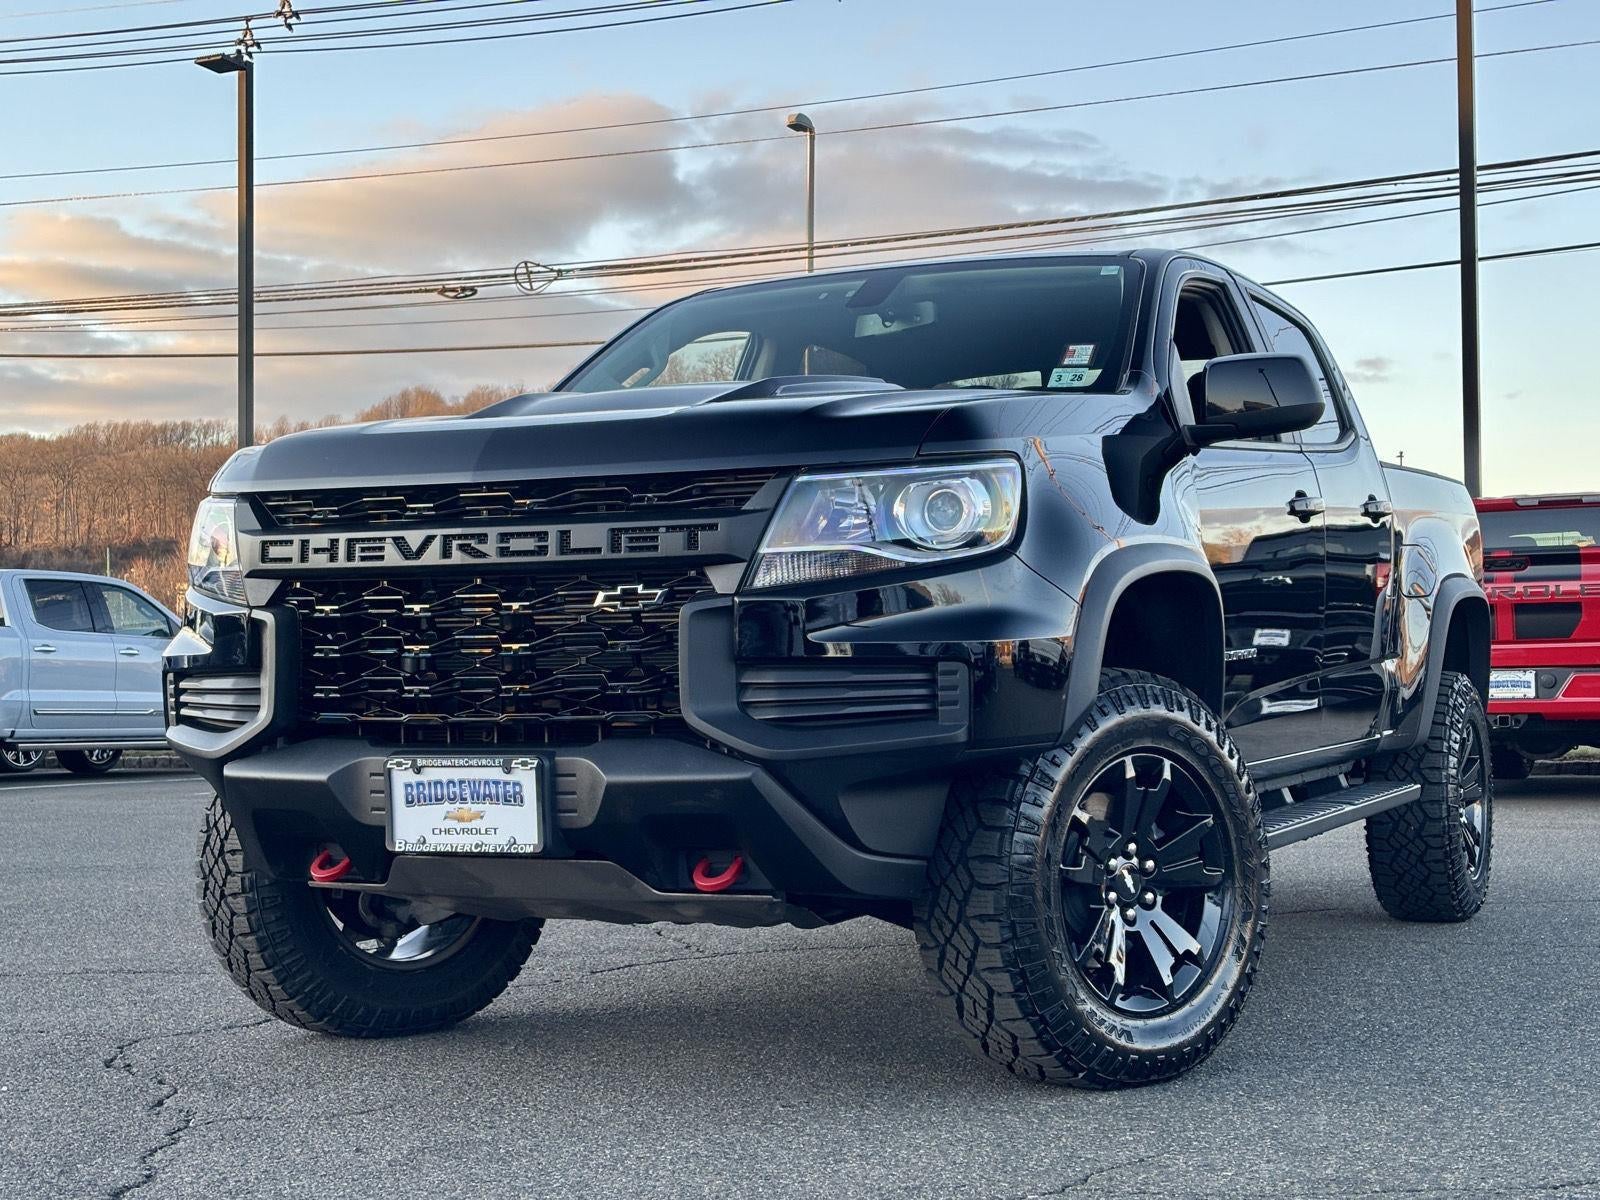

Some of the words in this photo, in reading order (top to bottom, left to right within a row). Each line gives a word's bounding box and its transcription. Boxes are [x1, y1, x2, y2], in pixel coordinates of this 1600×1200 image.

[1055, 374, 1063, 383] 3
[1069, 373, 1084, 382] 28
[259, 521, 720, 564] CHEVROLET
[1486, 583, 1600, 599] ROLE
[403, 778, 525, 808] BRIDGEWATER
[431, 827, 499, 836] CHEVROLET
